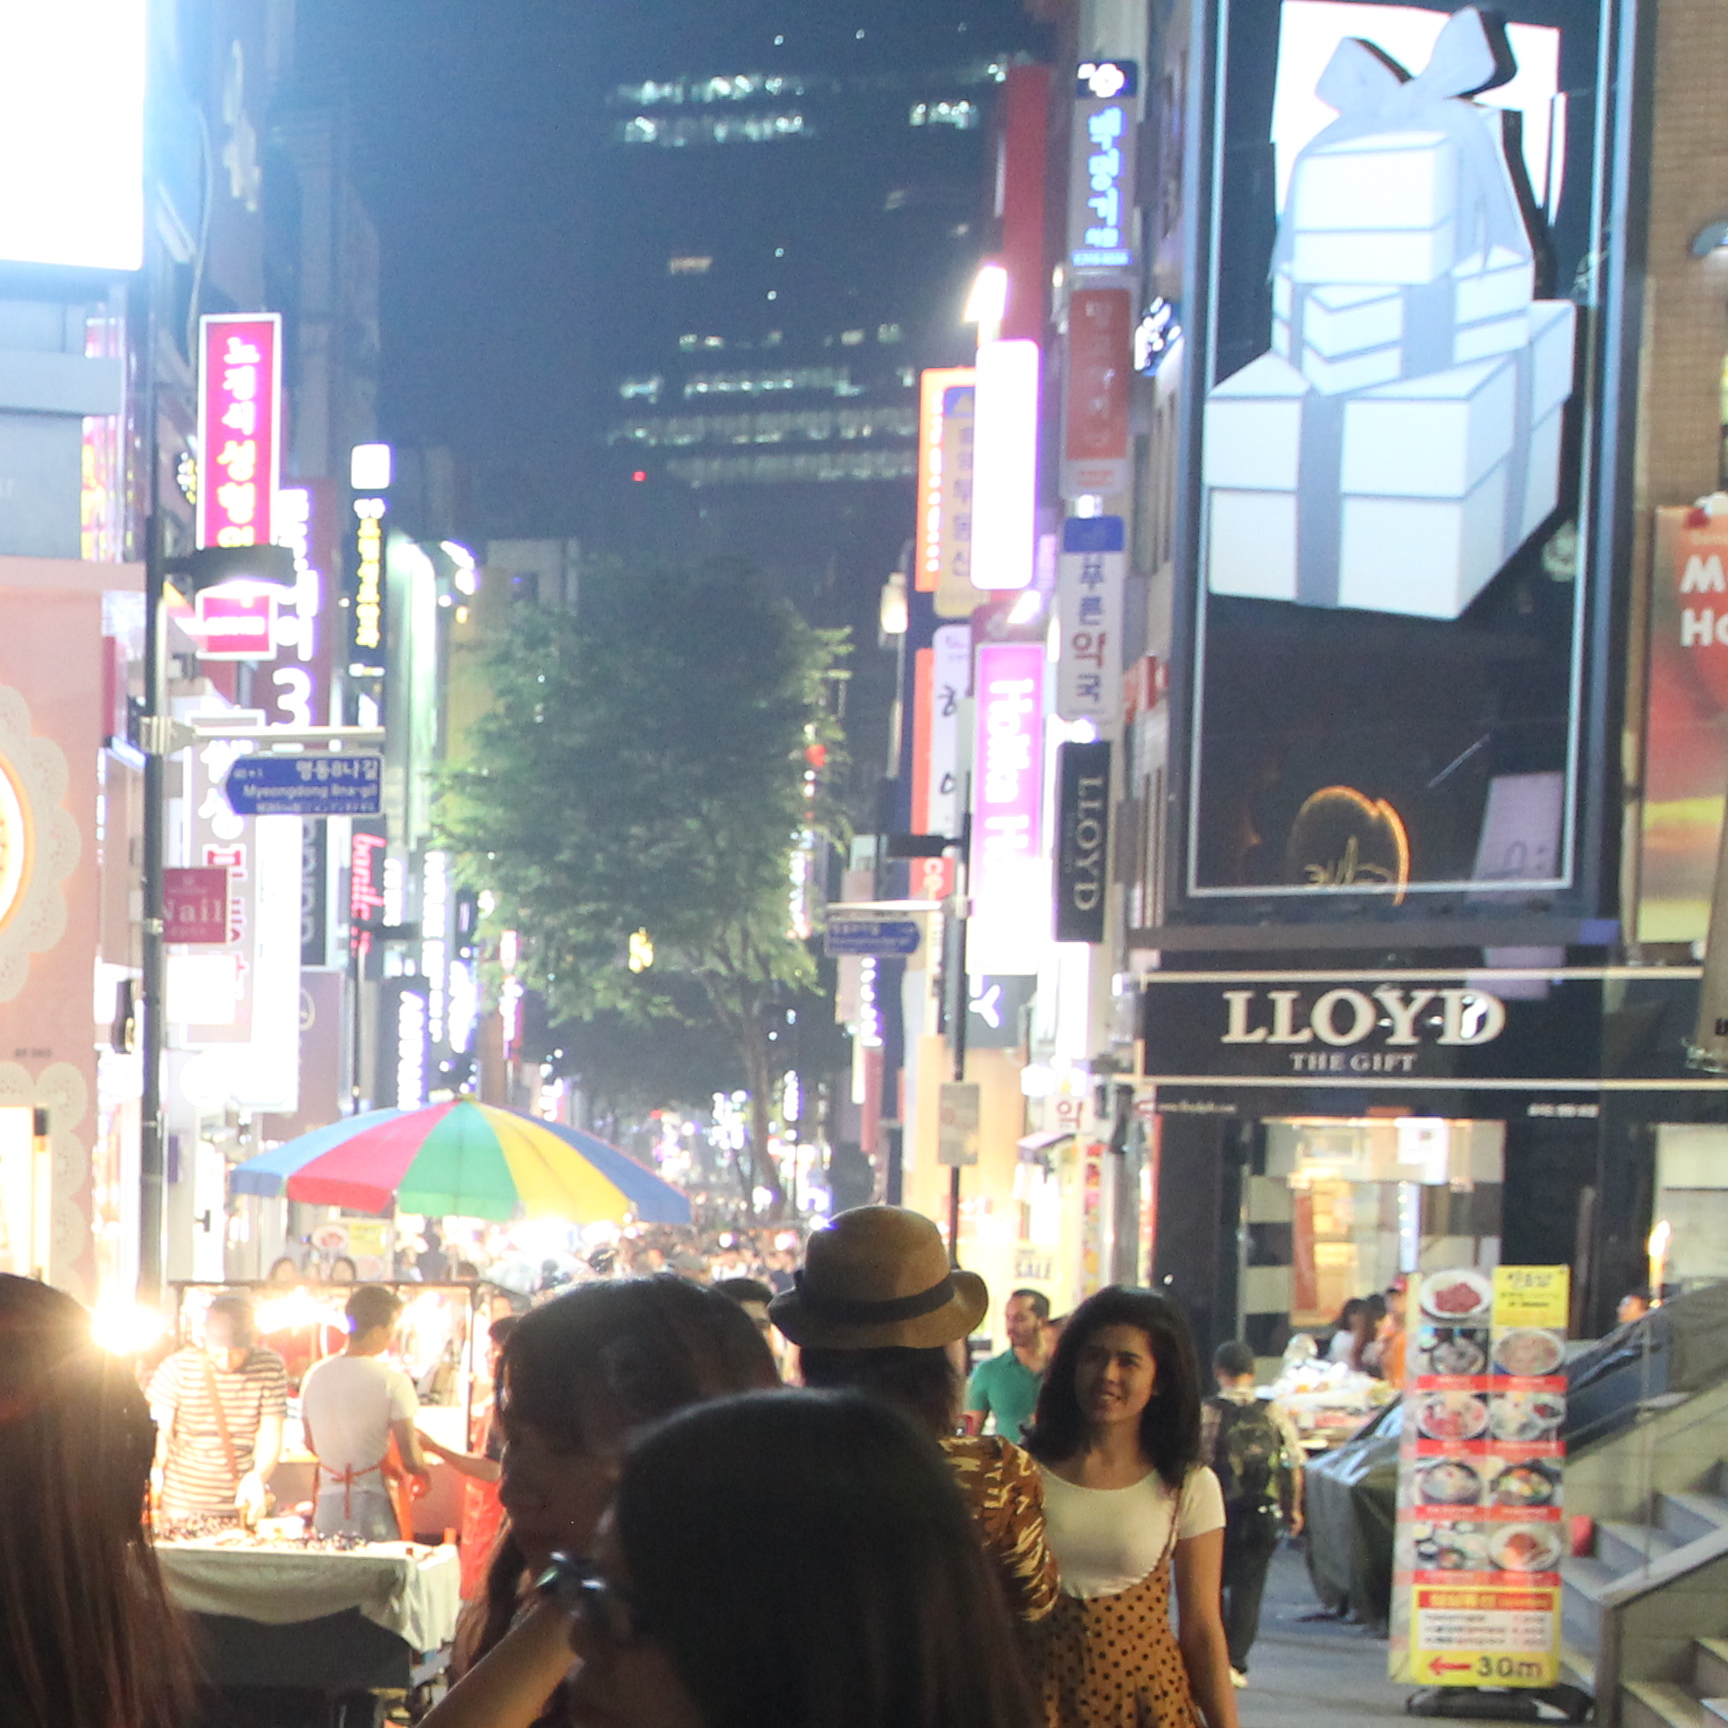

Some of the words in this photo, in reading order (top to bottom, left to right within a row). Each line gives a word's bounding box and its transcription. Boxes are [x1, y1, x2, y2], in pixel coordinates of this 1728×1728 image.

[1073, 775, 1104, 912] LLOYD
[1220, 986, 1507, 1046] LLOYD
[1290, 1052, 1344, 1072] THE
[1350, 1052, 1418, 1072] GIFT
[1475, 1655, 1544, 1679] 30m
